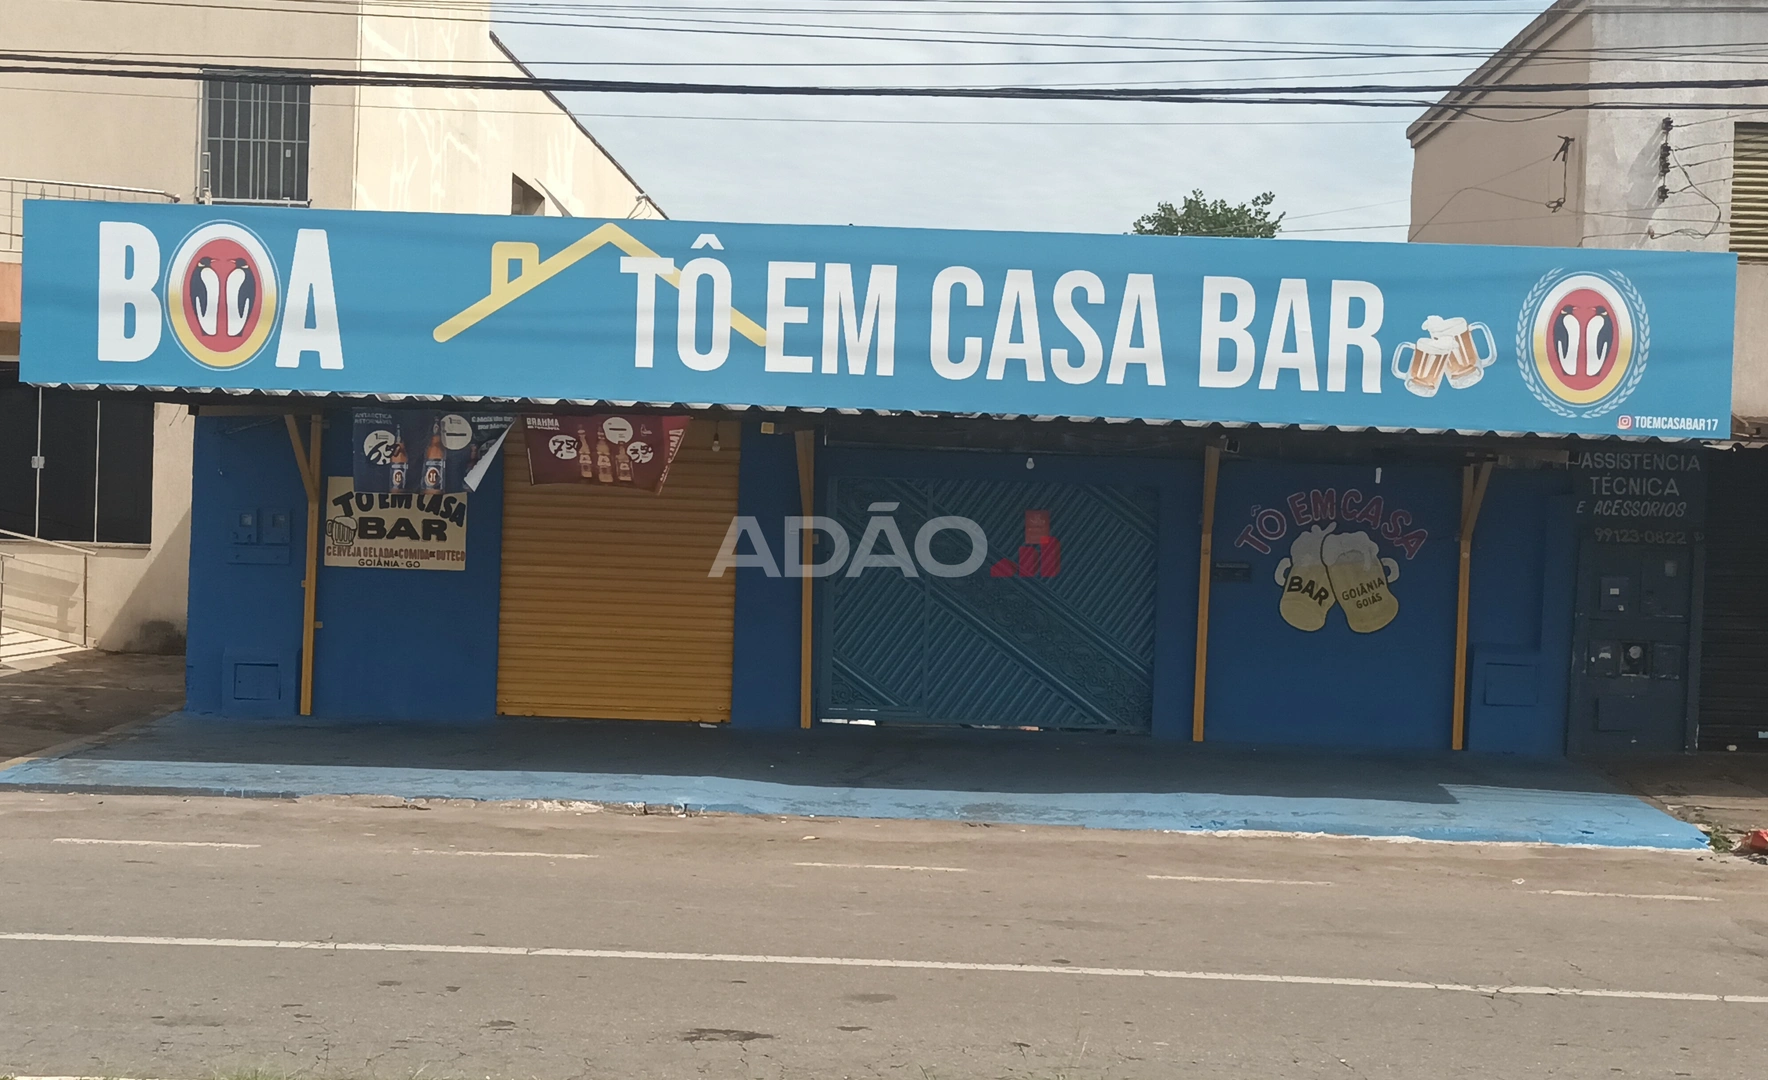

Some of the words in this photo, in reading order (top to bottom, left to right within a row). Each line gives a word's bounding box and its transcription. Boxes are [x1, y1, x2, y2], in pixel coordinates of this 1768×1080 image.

[619, 233, 732, 372] TÔ
[764, 260, 897, 377] EM
[930, 265, 1167, 387] CASA
[1198, 276, 1385, 394] BAR
[526, 417, 560, 427] BRAHMA
[1634, 416, 1719, 431] TOEMCASABAR17
[1589, 472, 1680, 496] TÉCNICA
[378, 493, 413, 510] EM
[416, 493, 467, 528] CASA
[1576, 501, 1586, 514] E
[1593, 497, 1687, 518] ACESSÓRIOS
[357, 516, 448, 542] BAR
[1287, 488, 1337, 526] EM
[1340, 488, 1429, 560] CASA
[1594, 527, 1687, 545] 99123-0822
[326, 545, 362, 558] CERVEJA
[363, 546, 395, 559] GELADA
[398, 548, 430, 560] COMIDA
[405, 560, 421, 569] GO
[1287, 575, 1330, 606] BAR
[1341, 577, 1385, 602] GOIÂNIA
[1355, 594, 1384, 610] GOIÁS
